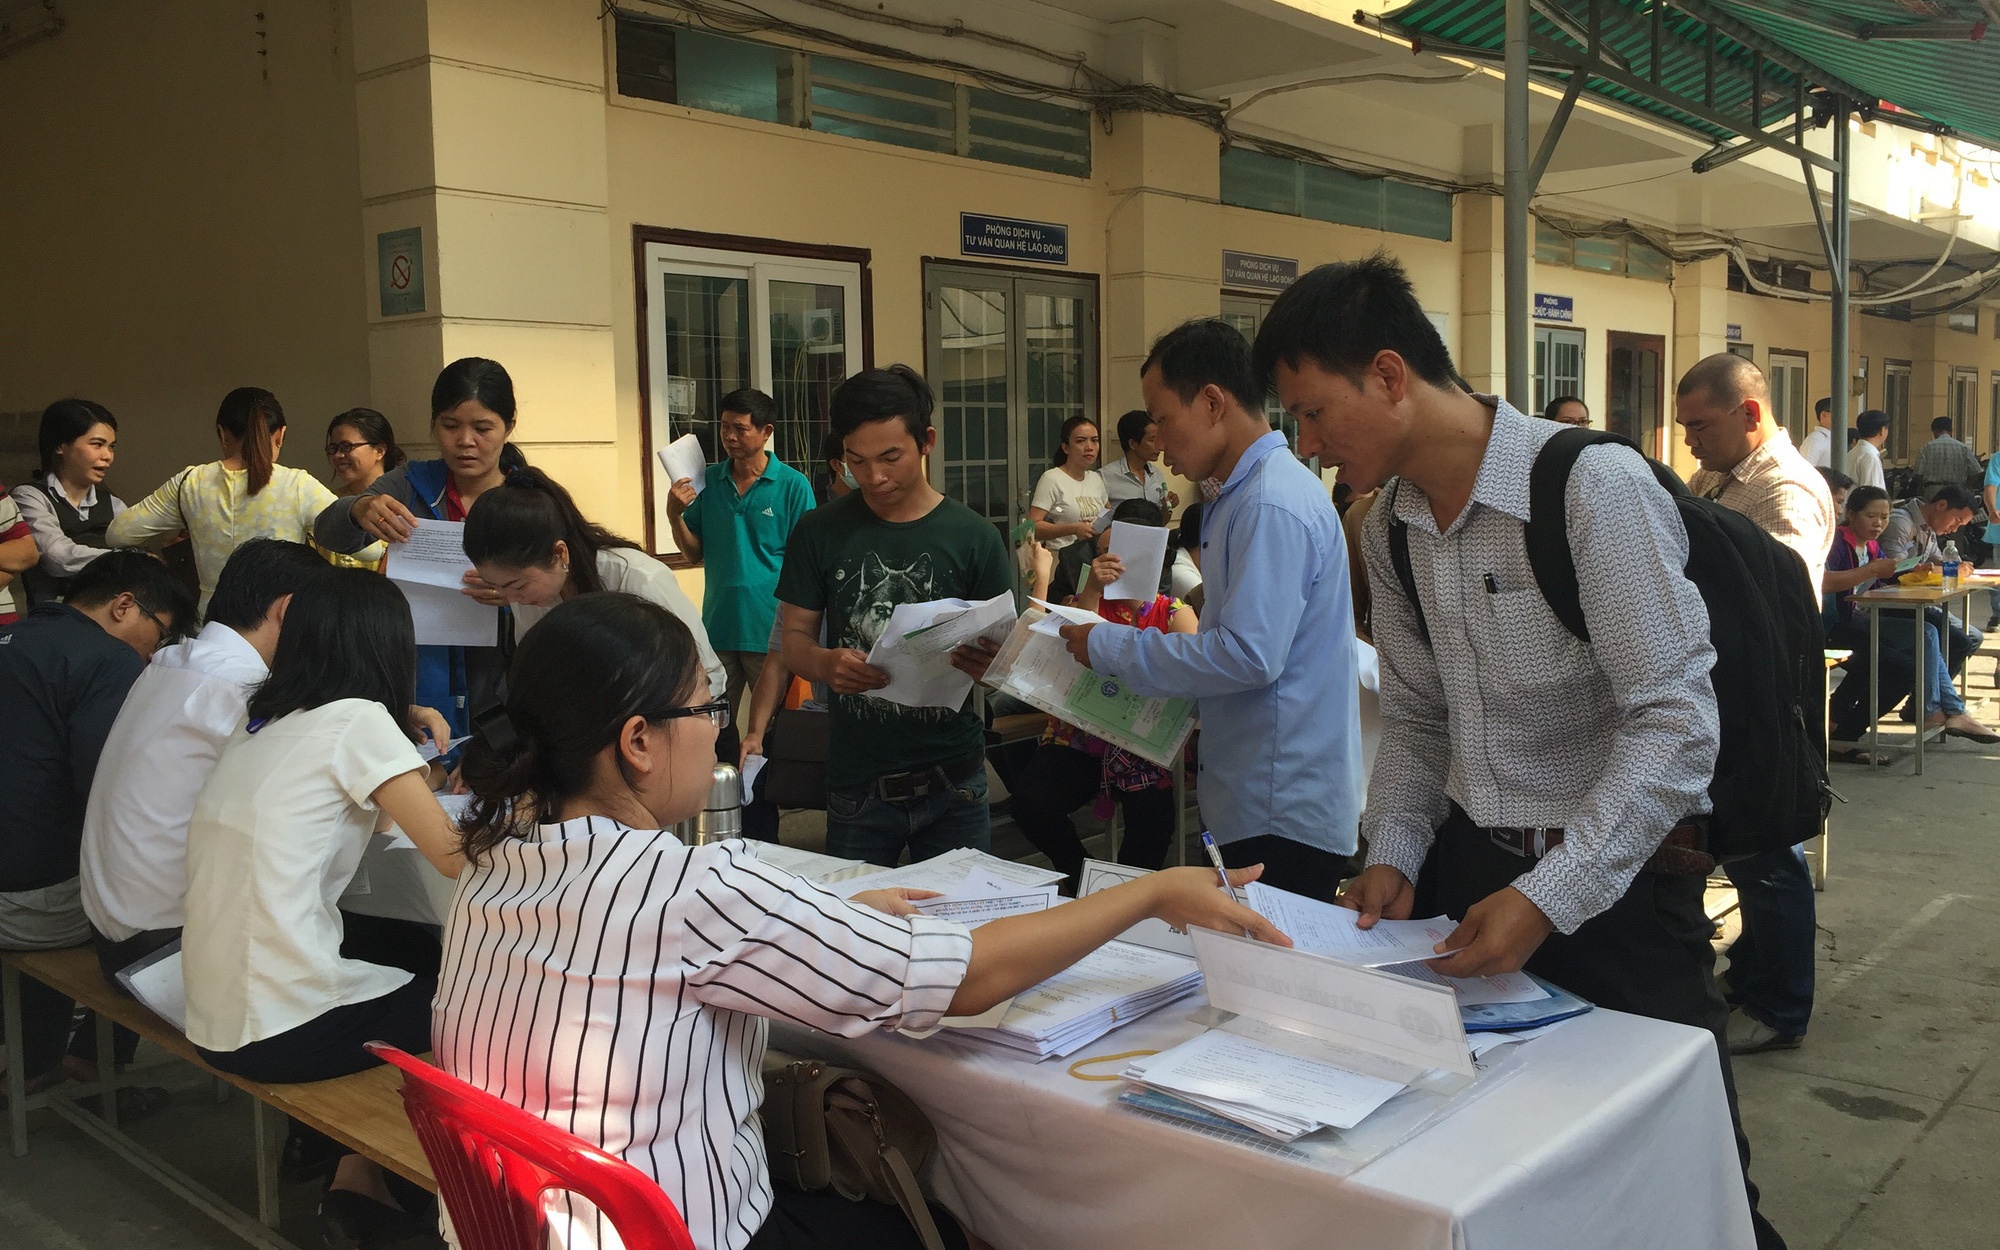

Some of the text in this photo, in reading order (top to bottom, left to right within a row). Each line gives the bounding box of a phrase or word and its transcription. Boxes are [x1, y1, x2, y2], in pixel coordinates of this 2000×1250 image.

[985, 223, 1012, 237] PHÒNG
[1012, 227, 1030, 239] DỊCH
[1031, 229, 1041, 242] VỤ
[965, 234, 1064, 256] TƯ VẤN QUAN HỆ LAO ĐỘNG
[1240, 259, 1258, 270] PHÒNG
[1246, 271, 1261, 281] QUAN
